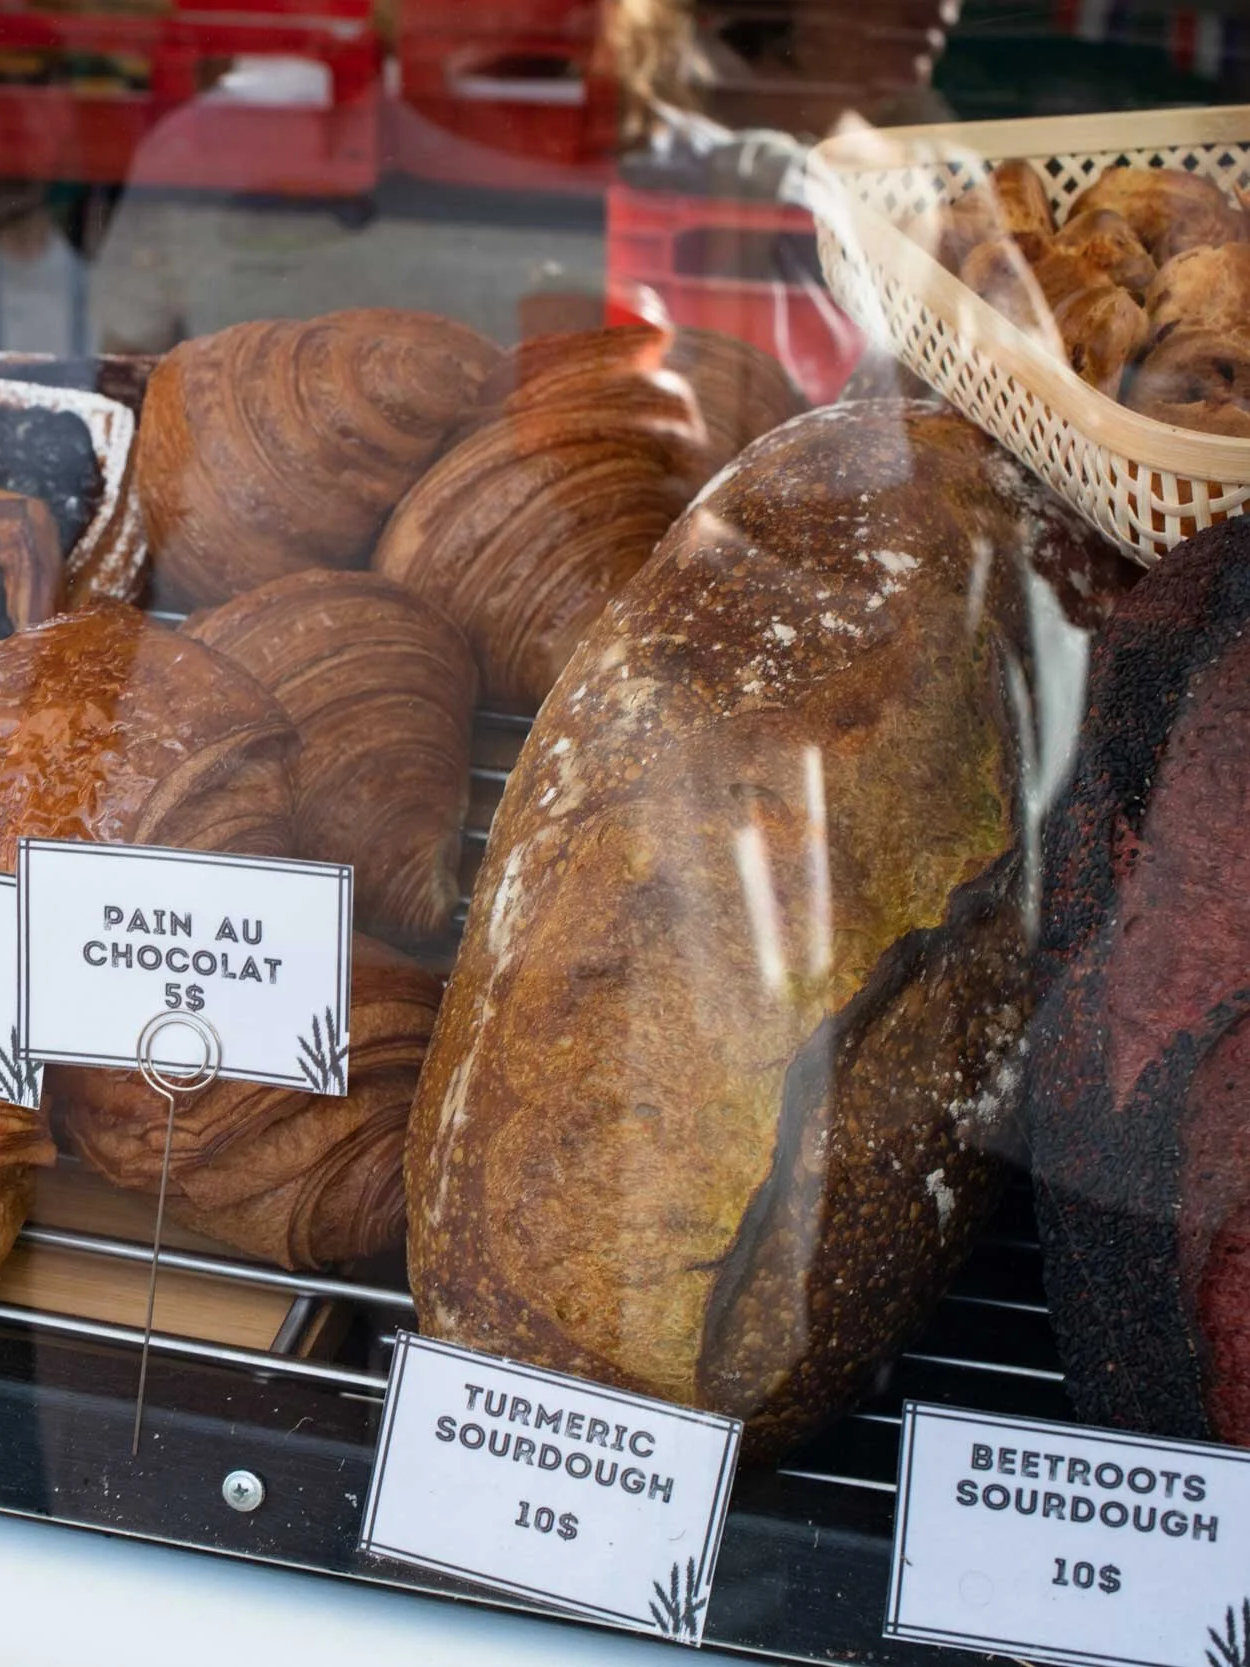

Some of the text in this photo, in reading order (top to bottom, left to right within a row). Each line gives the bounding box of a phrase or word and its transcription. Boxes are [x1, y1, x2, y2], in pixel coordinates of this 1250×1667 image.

[103, 905, 263, 945] PAIN AU
[82, 940, 283, 985] CHOCOLAT
[164, 983, 206, 1012] 5$
[464, 1383, 656, 1457] TURMERIC
[434, 1415, 675, 1503] SOURDOUGH
[970, 1443, 1207, 1502] BEETROOTS
[514, 1500, 579, 1541] 10$
[956, 1479, 1219, 1543] SOURDOUGH
[1051, 1557, 1122, 1594] 10$
